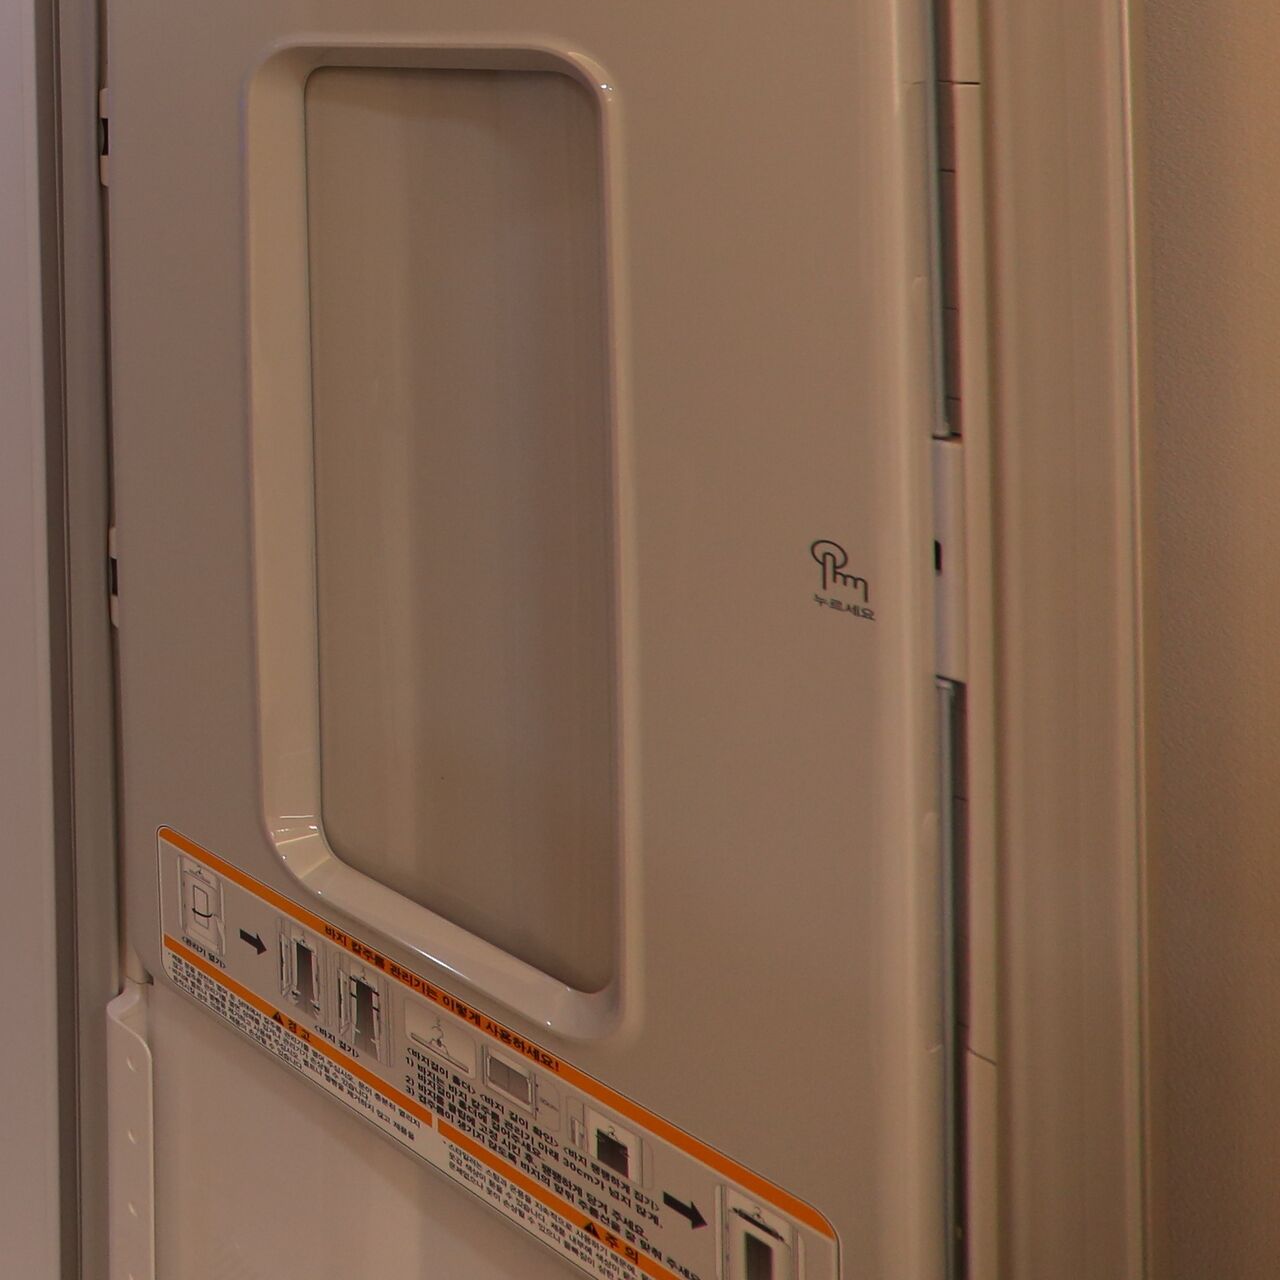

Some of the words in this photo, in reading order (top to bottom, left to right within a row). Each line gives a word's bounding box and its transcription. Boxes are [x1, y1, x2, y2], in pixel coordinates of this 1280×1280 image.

[813, 594, 876, 621] 누르세요
[324, 924, 346, 948] 바지
[390, 962, 438, 1003] 관리기는
[442, 993, 481, 1028] 이렇게
[485, 1018, 559, 1075] 사용하세요!
[417, 1071, 454, 1104] 바지걸이
[417, 1062, 445, 1088] 바지는
[448, 1082, 467, 1103] 바지
[504, 1118, 534, 1146] 관리기
[538, 1139, 559, 1162] 아래
[562, 1155, 604, 1191] 30cm가
[609, 1185, 631, 1209] 넘지
[509, 1109, 528, 1131] 길이
[457, 1117, 484, 1144] 생기지
[520, 1159, 550, 1188] 바지의
[478, 1121, 497, 1142] 고정
[501, 1135, 520, 1157] 시킨
